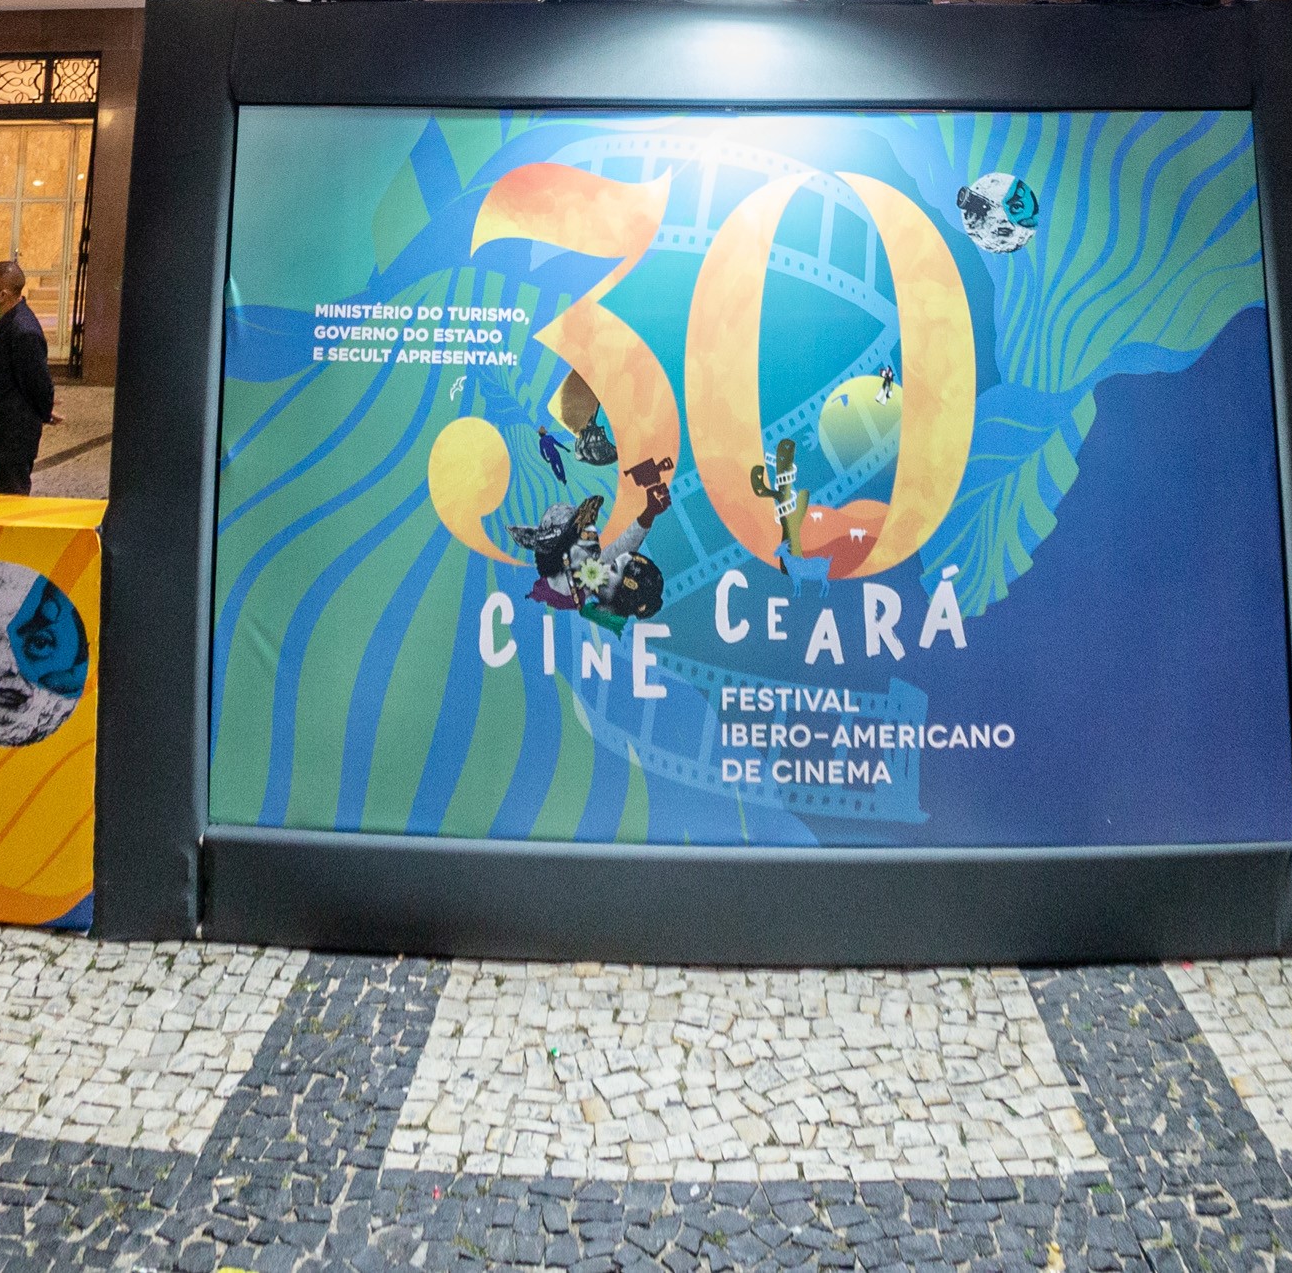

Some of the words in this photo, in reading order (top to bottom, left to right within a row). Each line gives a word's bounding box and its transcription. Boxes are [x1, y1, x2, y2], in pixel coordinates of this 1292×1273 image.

[315, 302, 413, 320] MINISTÉRIO
[417, 307, 443, 321] DO
[447, 307, 531, 325] TURISMO,
[314, 325, 399, 341] GOVERNO
[403, 328, 429, 342] DO
[433, 329, 503, 344] ESTADO
[313, 347, 324, 362] E
[327, 347, 392, 363] SECULT
[395, 349, 519, 366] APRESENTAM:
[427, 161, 978, 582] 30
[479, 593, 672, 700] CINE
[714, 564, 969, 666] CEARÁ
[721, 688, 860, 714] FESTIVAL
[721, 723, 1016, 750] IBERO-AMERICANO
[721, 760, 762, 784] DE
[770, 760, 892, 785] CINEMA
